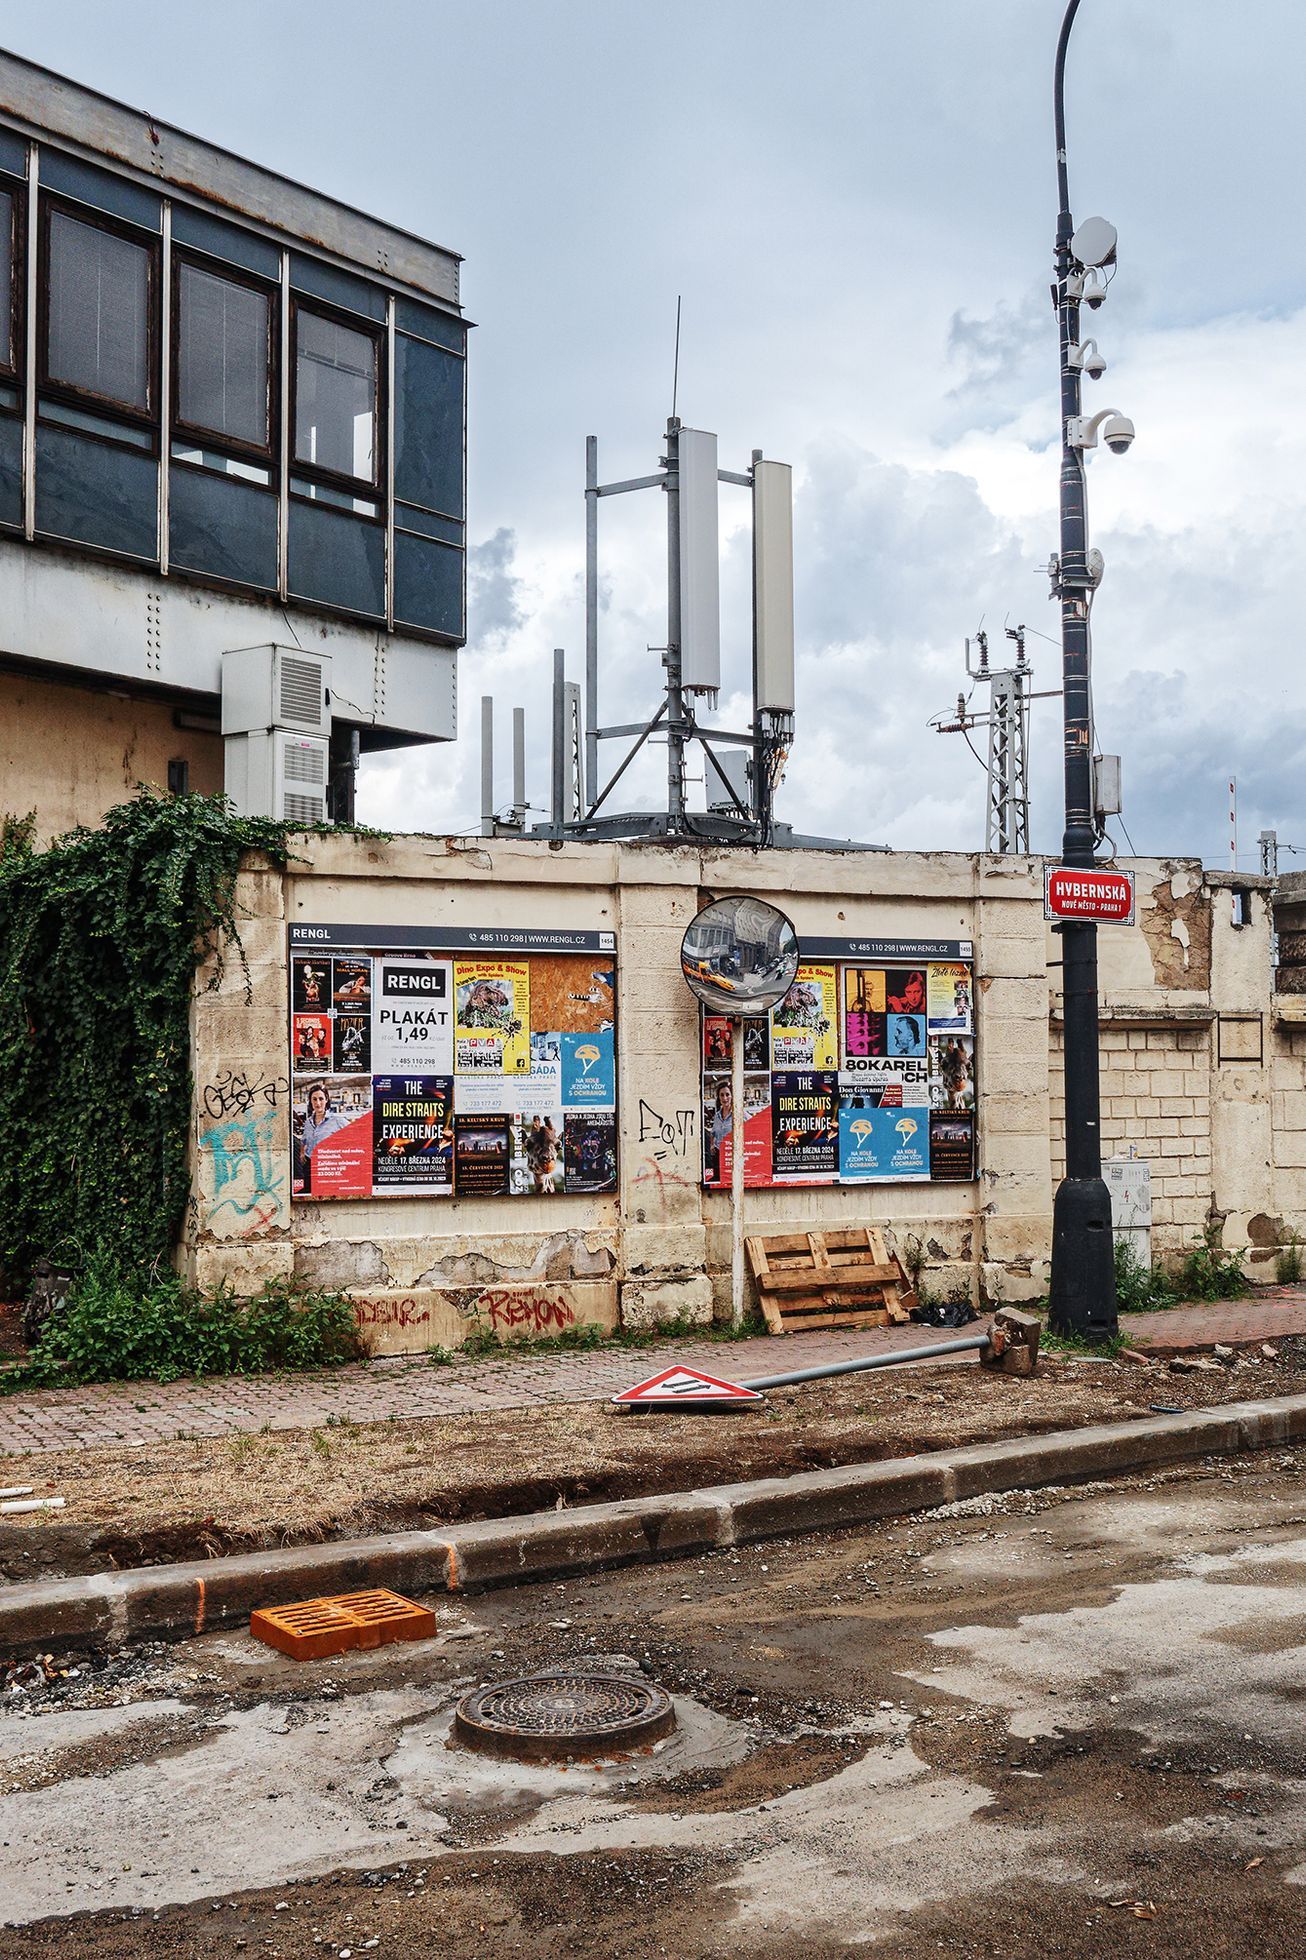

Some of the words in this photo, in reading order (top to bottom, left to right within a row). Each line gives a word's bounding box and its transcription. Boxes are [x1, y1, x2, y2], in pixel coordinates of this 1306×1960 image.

[1056, 881, 1126, 900] HYBERNSKÁ
[1062, 900, 1076, 909] NOVÉ
[1078, 900, 1095, 910] MĚSTO
[1100, 903, 1117, 912] PRAHA
[293, 929, 330, 938] RENGL
[529, 935, 585, 944] WWW.RENGL.CZ
[456, 966, 474, 974] Dino
[476, 964, 495, 972] Expo
[506, 966, 527, 975] Show
[815, 969, 833, 978] Show
[388, 975, 440, 990] RENGL
[380, 1008, 448, 1025] PLAKÁT
[396, 1027, 428, 1043] 1,49
[405, 1081, 423, 1095] THE
[797, 1077, 813, 1090] THE
[383, 1102, 404, 1117] DIRE
[406, 1102, 444, 1117] STRAITS
[780, 1098, 798, 1111] DIRE
[799, 1097, 831, 1110] STRAITS
[780, 1117, 831, 1131] EXPERIENCE
[383, 1124, 443, 1139] EXPERIENCE
[822, 1146, 834, 1154] 2024
[378, 1156, 398, 1164] NEDĚLE
[409, 1156, 430, 1164] BŘEZNA
[432, 1156, 446, 1164] 2024
[514, 1169, 523, 1192] ZOO
